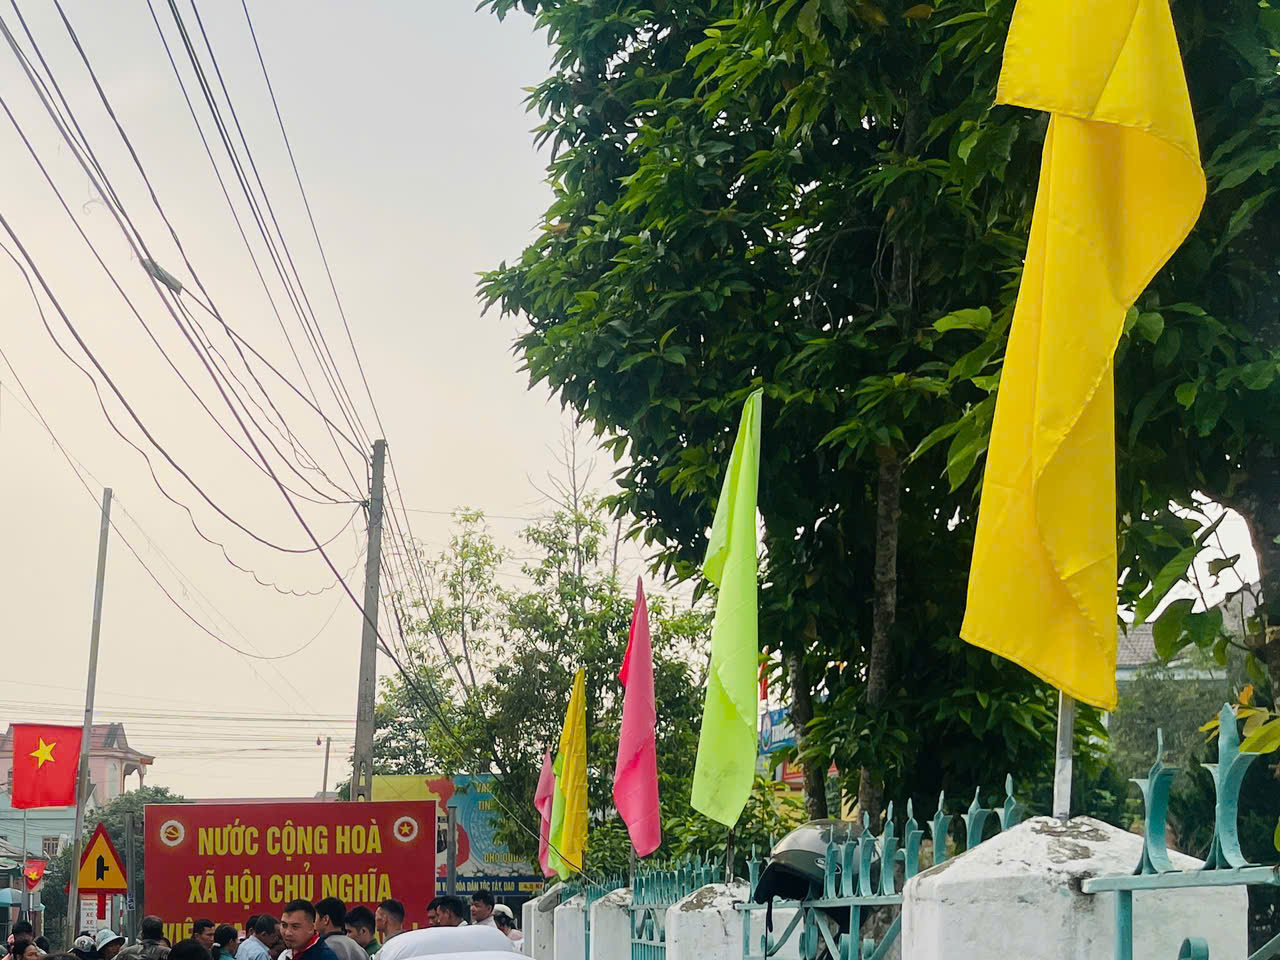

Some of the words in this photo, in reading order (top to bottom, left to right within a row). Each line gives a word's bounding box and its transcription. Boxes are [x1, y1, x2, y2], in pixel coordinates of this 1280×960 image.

[198, 818, 259, 856] NƯỚC
[266, 819, 328, 861] CỘNG
[335, 818, 382, 855] HOÀ
[188, 869, 218, 904] XÃ
[224, 868, 261, 909] HỘI
[269, 862, 314, 903] CHỦ
[321, 868, 392, 903] NGHĨA
